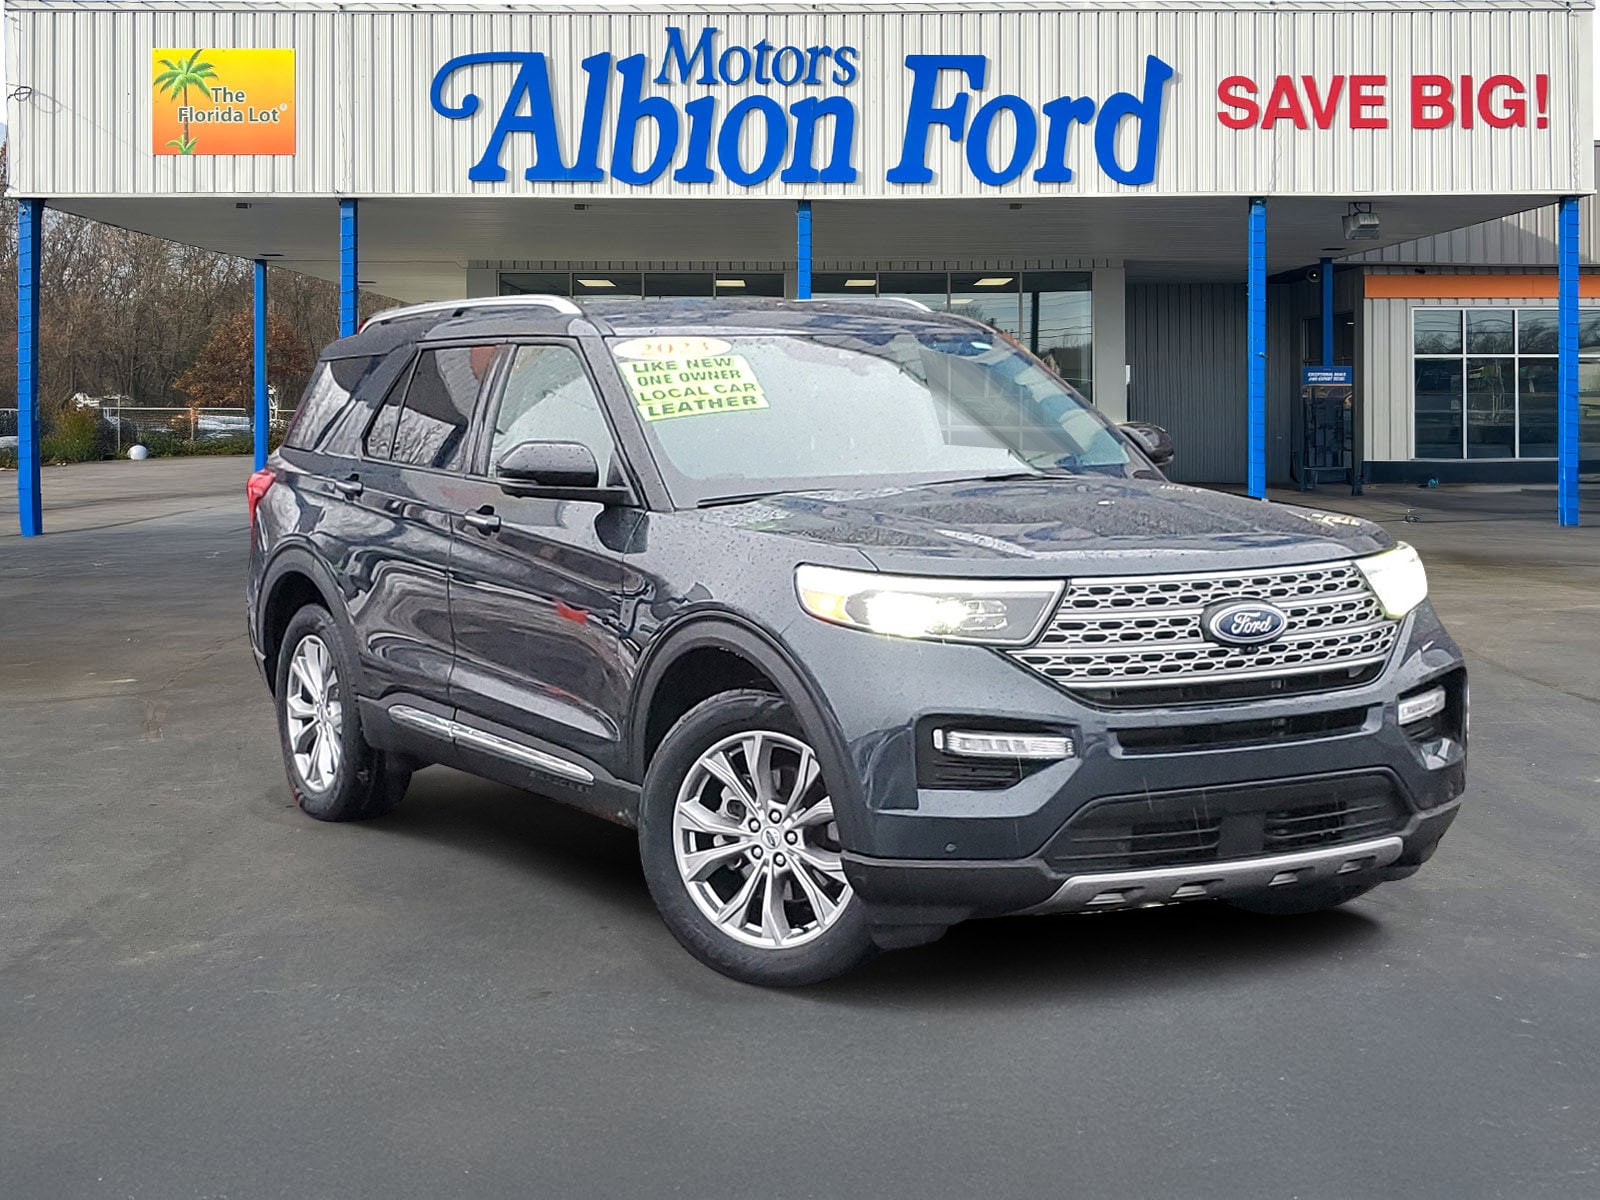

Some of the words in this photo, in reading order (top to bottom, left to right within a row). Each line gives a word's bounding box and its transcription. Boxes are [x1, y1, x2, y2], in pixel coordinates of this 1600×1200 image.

[653, 27, 857, 86] Motors
[211, 87, 245, 102] The
[1217, 75, 1389, 130] SAVE
[1410, 74, 1548, 130] BIG!
[178, 107, 243, 122] Florida
[249, 107, 279, 122] Lot
[430, 51, 857, 186] Albion
[886, 54, 1174, 187] Ford
[632, 360, 678, 373] LIKE
[686, 357, 731, 369] NEW
[637, 374, 673, 386] ONE
[679, 369, 741, 382] OWNER
[640, 386, 709, 401] LOCAL
[714, 382, 756, 394] CAR
[648, 395, 757, 416] LEATHER
[1231, 611, 1272, 634] Ford
